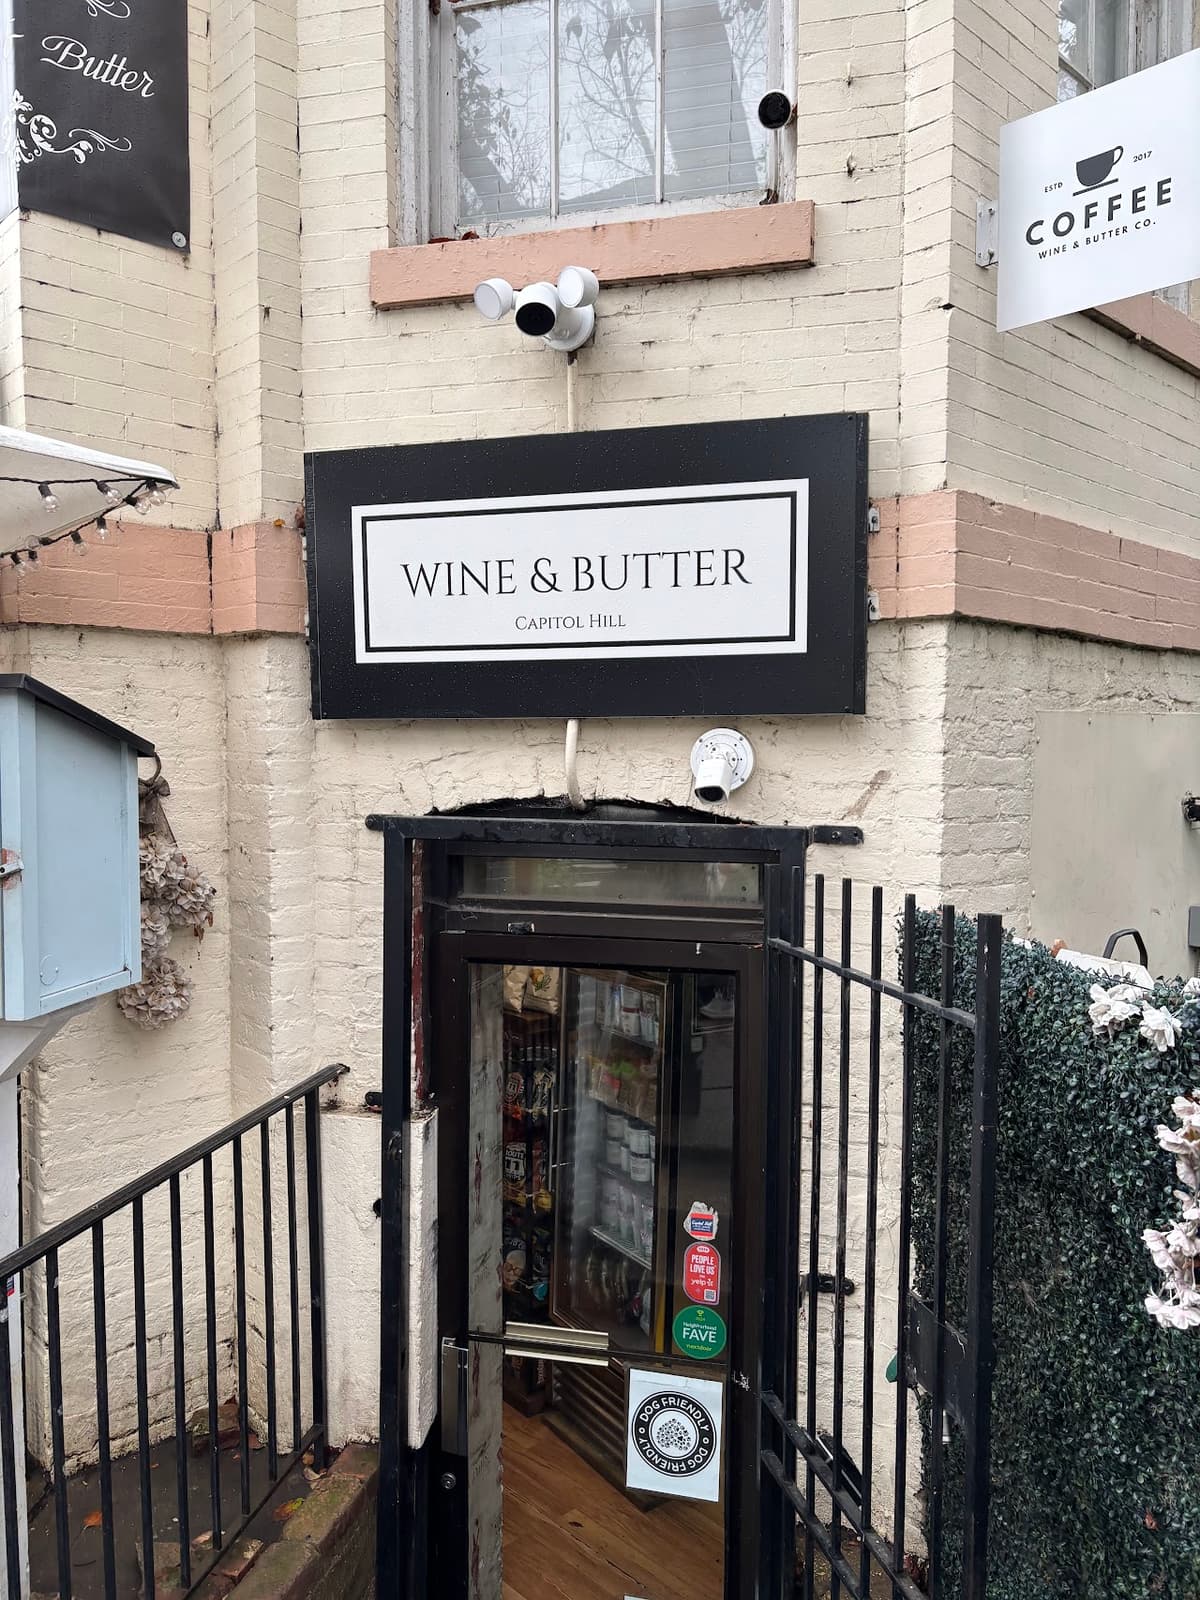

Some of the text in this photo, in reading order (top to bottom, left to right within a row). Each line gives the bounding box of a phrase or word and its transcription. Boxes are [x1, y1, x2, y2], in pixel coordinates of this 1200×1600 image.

[40, 35, 155, 98] Butter
[1133, 151, 1153, 163] 2017
[1044, 182, 1063, 193] ESTD
[1025, 177, 1172, 246] COFFEE
[1038, 217, 1157, 260] WINE & BUTTER CO.
[400, 548, 752, 597] WINE & BUTTER
[690, 1264, 715, 1275] LOVE US
[691, 1254, 715, 1265] PEOPLE
[690, 1278, 706, 1286] yelp
[682, 1328, 717, 1343] FAVE
[639, 1397, 709, 1432] DOG FRIENDLY
[638, 1436, 709, 1473] DOG FRIENDLY
